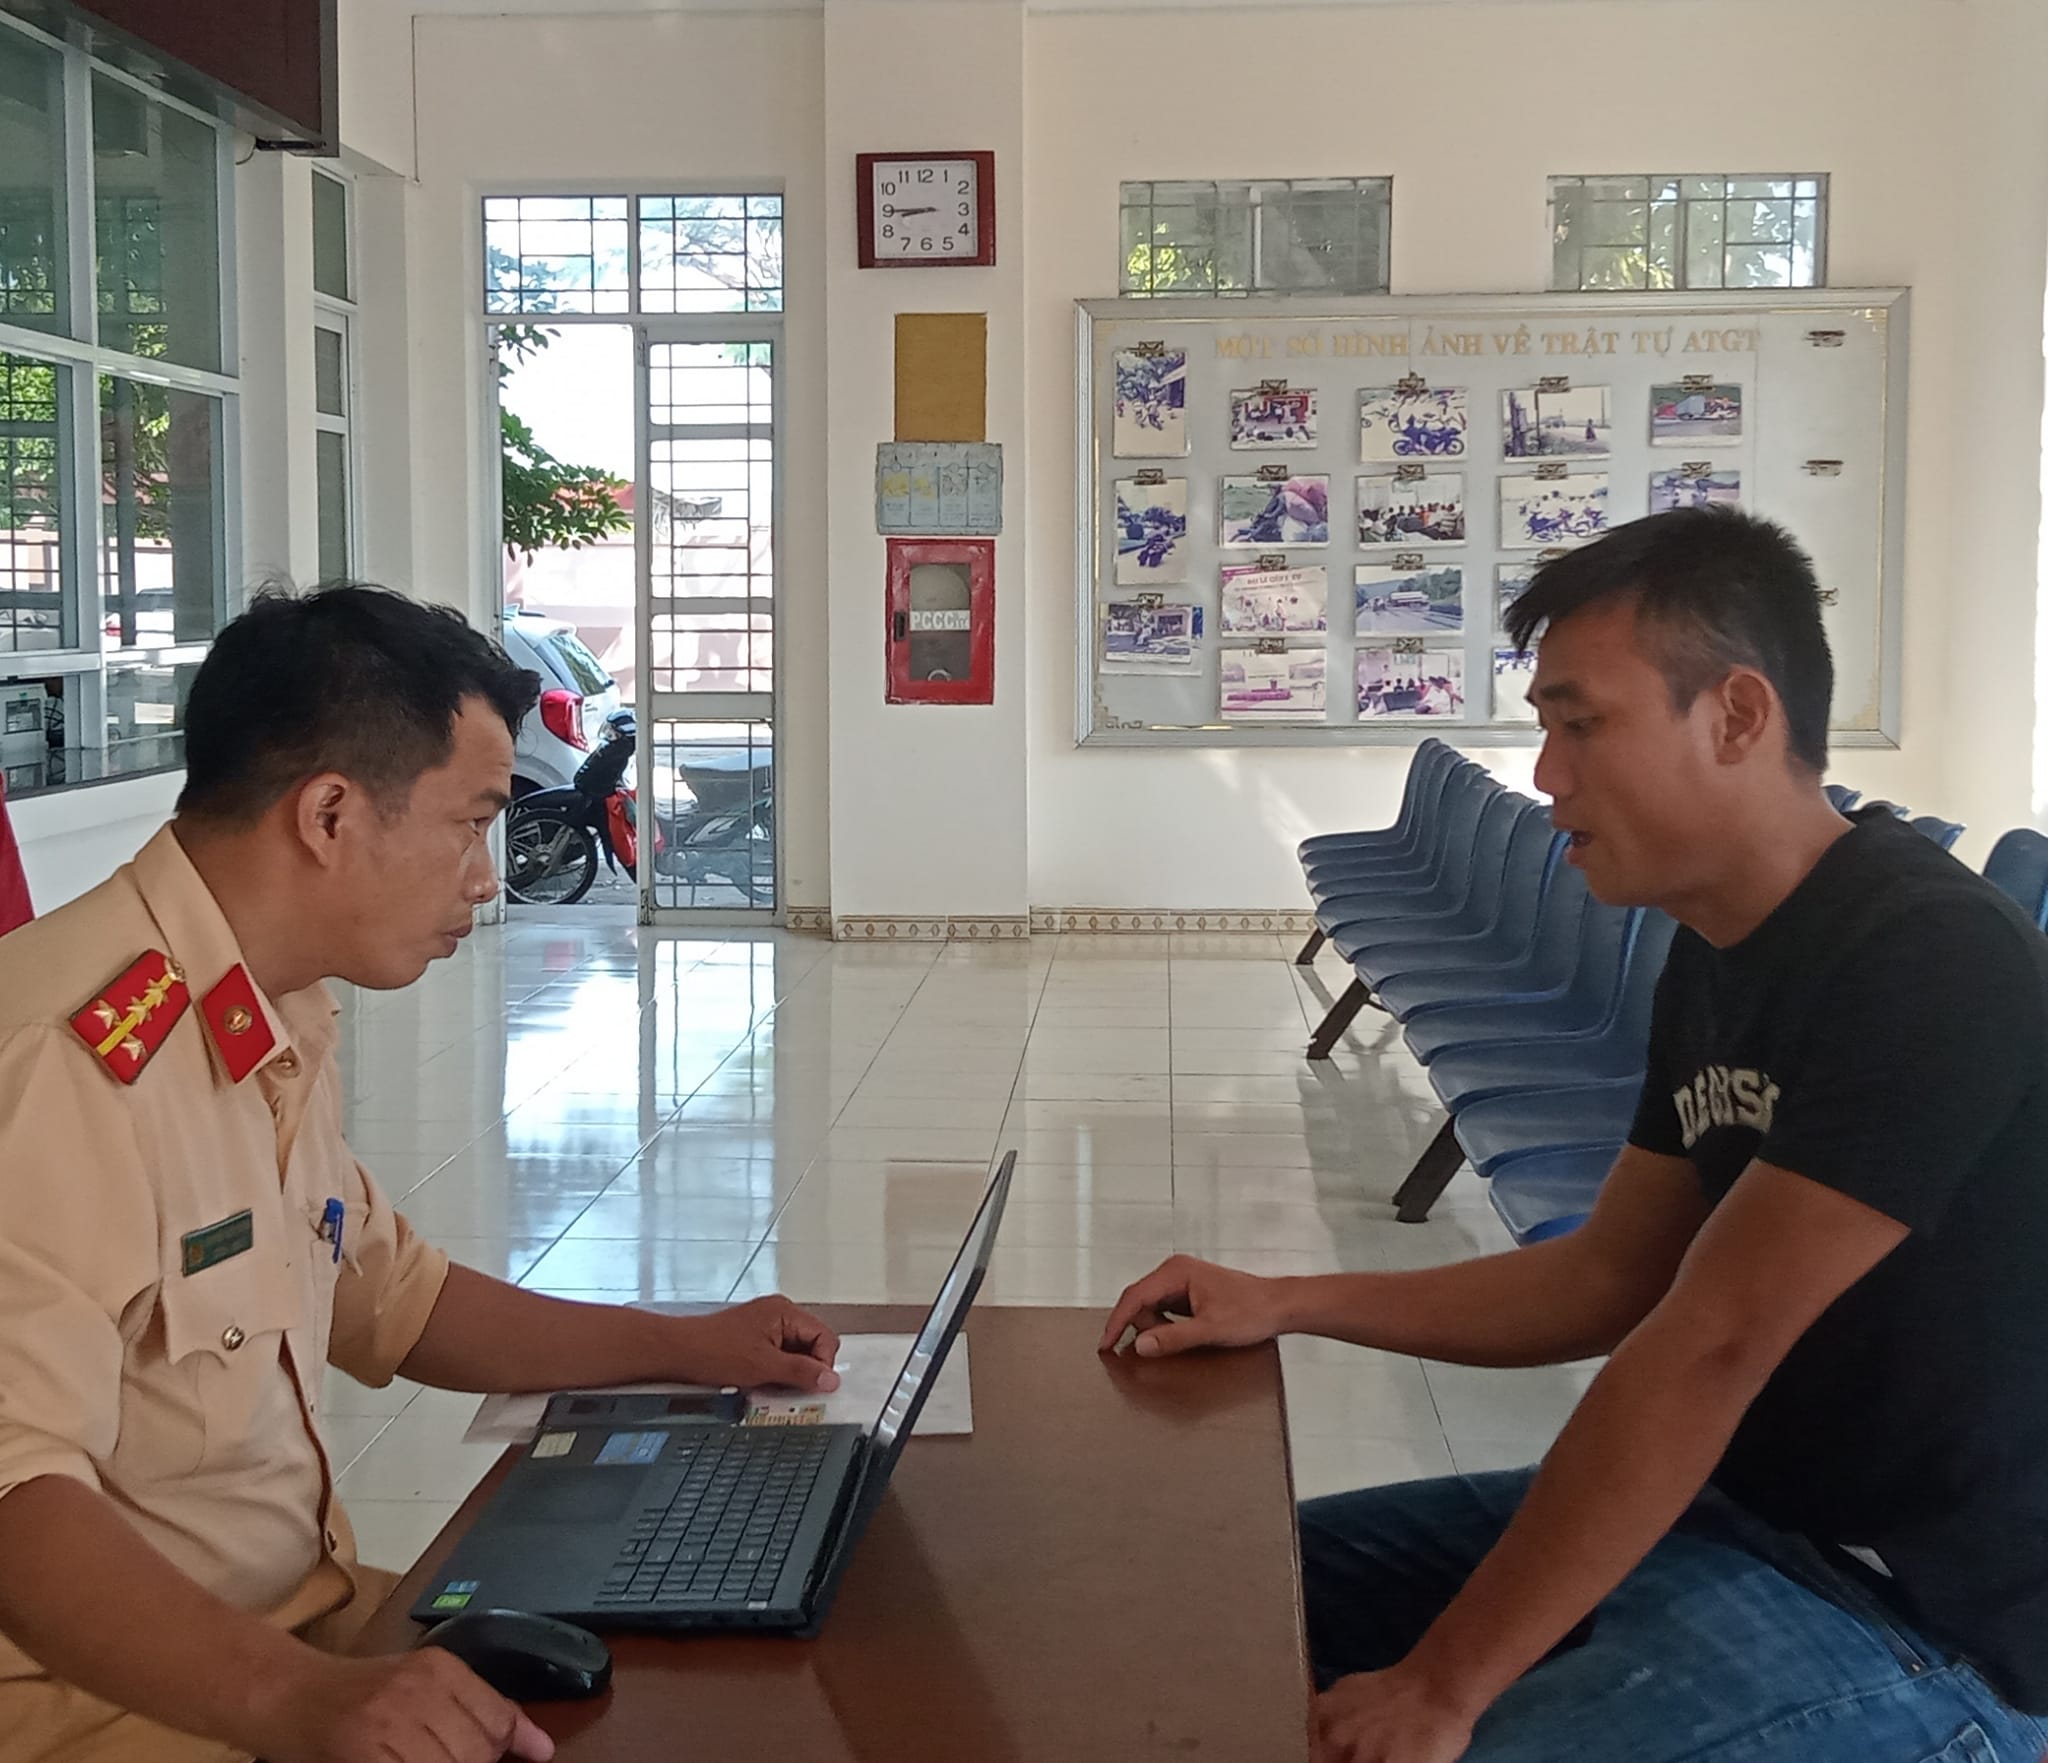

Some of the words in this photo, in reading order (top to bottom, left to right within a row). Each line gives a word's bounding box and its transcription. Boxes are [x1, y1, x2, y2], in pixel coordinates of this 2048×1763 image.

[898, 169, 910, 184] 11
[917, 168, 934, 184] 12
[880, 181, 896, 196] 10
[957, 180, 970, 195] 2
[882, 203, 895, 218] 9
[957, 202, 970, 217] 3
[882, 224, 894, 239] 8
[957, 222, 970, 237] 4
[900, 237, 911, 252] 7
[920, 236, 933, 251] 6
[942, 236, 954, 251] 5
[1420, 325, 1484, 357] ẢNH
[1542, 326, 1619, 359] TRẬT
[1632, 325, 1675, 358] TỰ
[1681, 328, 1761, 354] ATGT
[911, 610, 955, 631] PCCC
